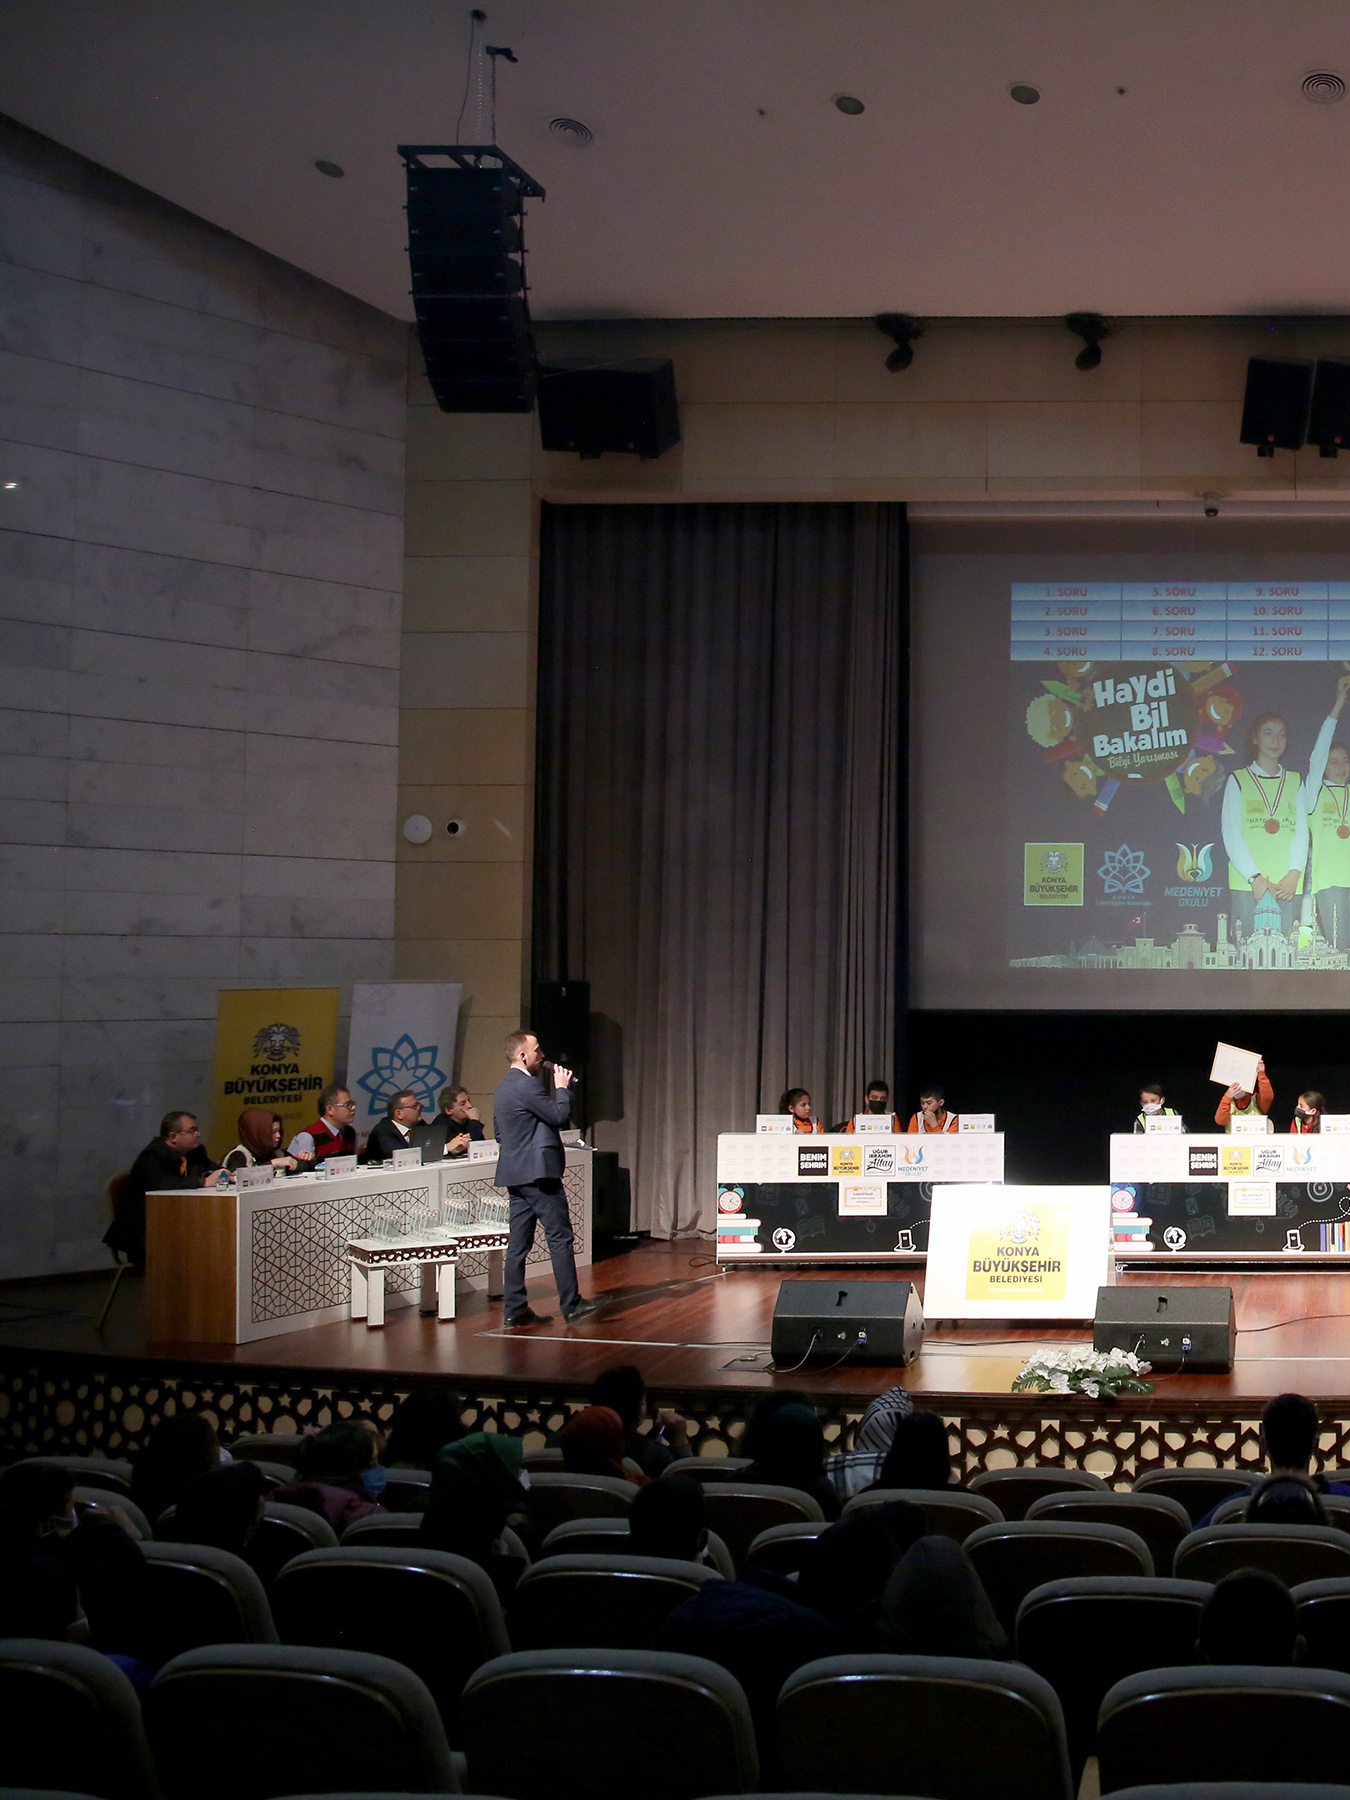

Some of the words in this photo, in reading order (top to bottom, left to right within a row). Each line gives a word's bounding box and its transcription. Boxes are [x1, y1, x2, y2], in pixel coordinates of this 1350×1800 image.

[1046, 588, 1054, 597] 1.
[1057, 588, 1088, 597] SORU
[1153, 588, 1162, 597] 5.
[1166, 588, 1196, 597] SORU
[1256, 588, 1266, 596] 9.
[1269, 588, 1299, 596] SORU
[1045, 607, 1054, 616] 2.
[1057, 607, 1088, 616] SORU
[1153, 607, 1162, 616] 6.
[1166, 607, 1196, 616] SORU
[1254, 606, 1269, 616] 10.
[1272, 606, 1302, 616] SORU
[1045, 627, 1054, 636] 3.
[1057, 627, 1087, 636] SORU
[1153, 627, 1162, 636] 7.
[1166, 627, 1196, 636] SORU
[1253, 627, 1268, 636] 11.
[1272, 627, 1302, 636] SORU
[1044, 648, 1053, 656] 4.
[1057, 648, 1087, 656] SORU
[1152, 648, 1162, 656] 8.
[1166, 648, 1196, 656] SORU
[1253, 647, 1268, 656] 12.
[1272, 647, 1302, 656] SORU
[1093, 668, 1176, 708] Haydi
[1130, 701, 1169, 731] Bil
[1093, 727, 1188, 757] Bakalım
[1164, 887, 1224, 897] MEDENİYET
[1179, 897, 1208, 906] OKULU
[251, 1064, 299, 1075] KONYA
[224, 1075, 323, 1095] BÜYÜKŞEHİR
[243, 1094, 302, 1105] BELEDİYESİ
[866, 1158, 893, 1171] Altay
[1256, 1158, 1282, 1171] Altay
[996, 1246, 1040, 1257] KONYA
[973, 1257, 1061, 1274] BÜYÜKŞEHİR
[989, 1274, 1043, 1283] BELEDİYESİ
